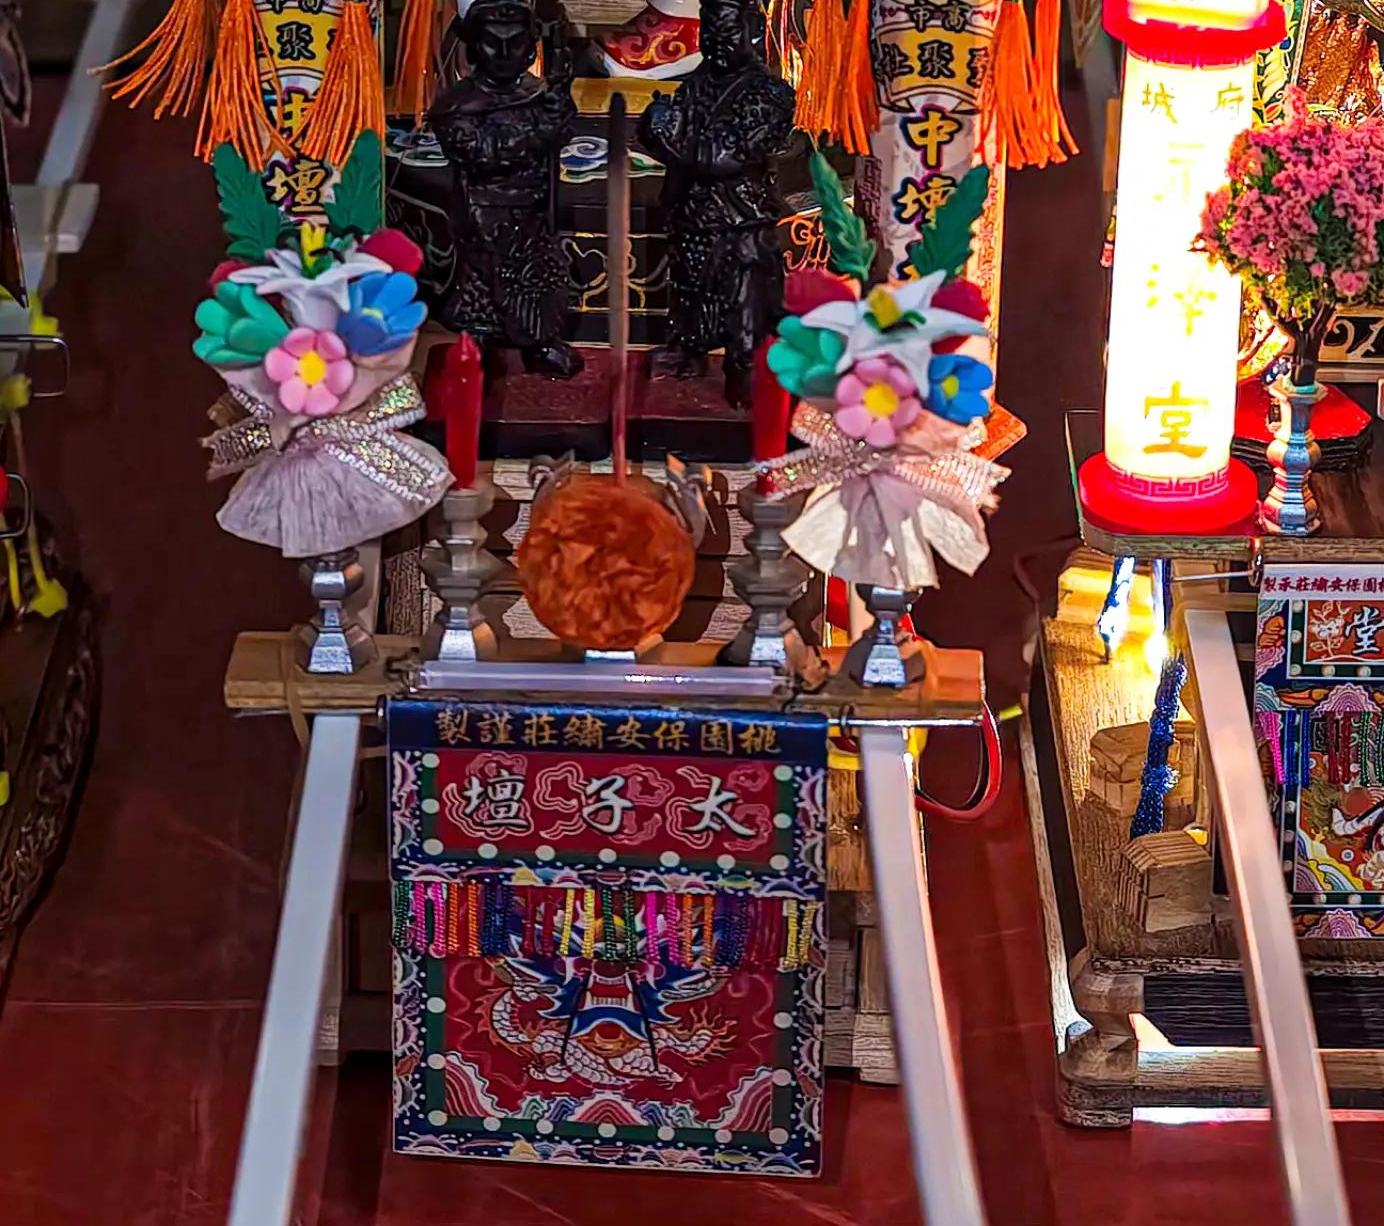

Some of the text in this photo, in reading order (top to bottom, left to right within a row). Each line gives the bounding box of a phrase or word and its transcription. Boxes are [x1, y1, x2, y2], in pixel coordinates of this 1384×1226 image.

[436, 708, 781, 755] 桃園保安繡莊謹製
[463, 769, 757, 837] 太子壇
